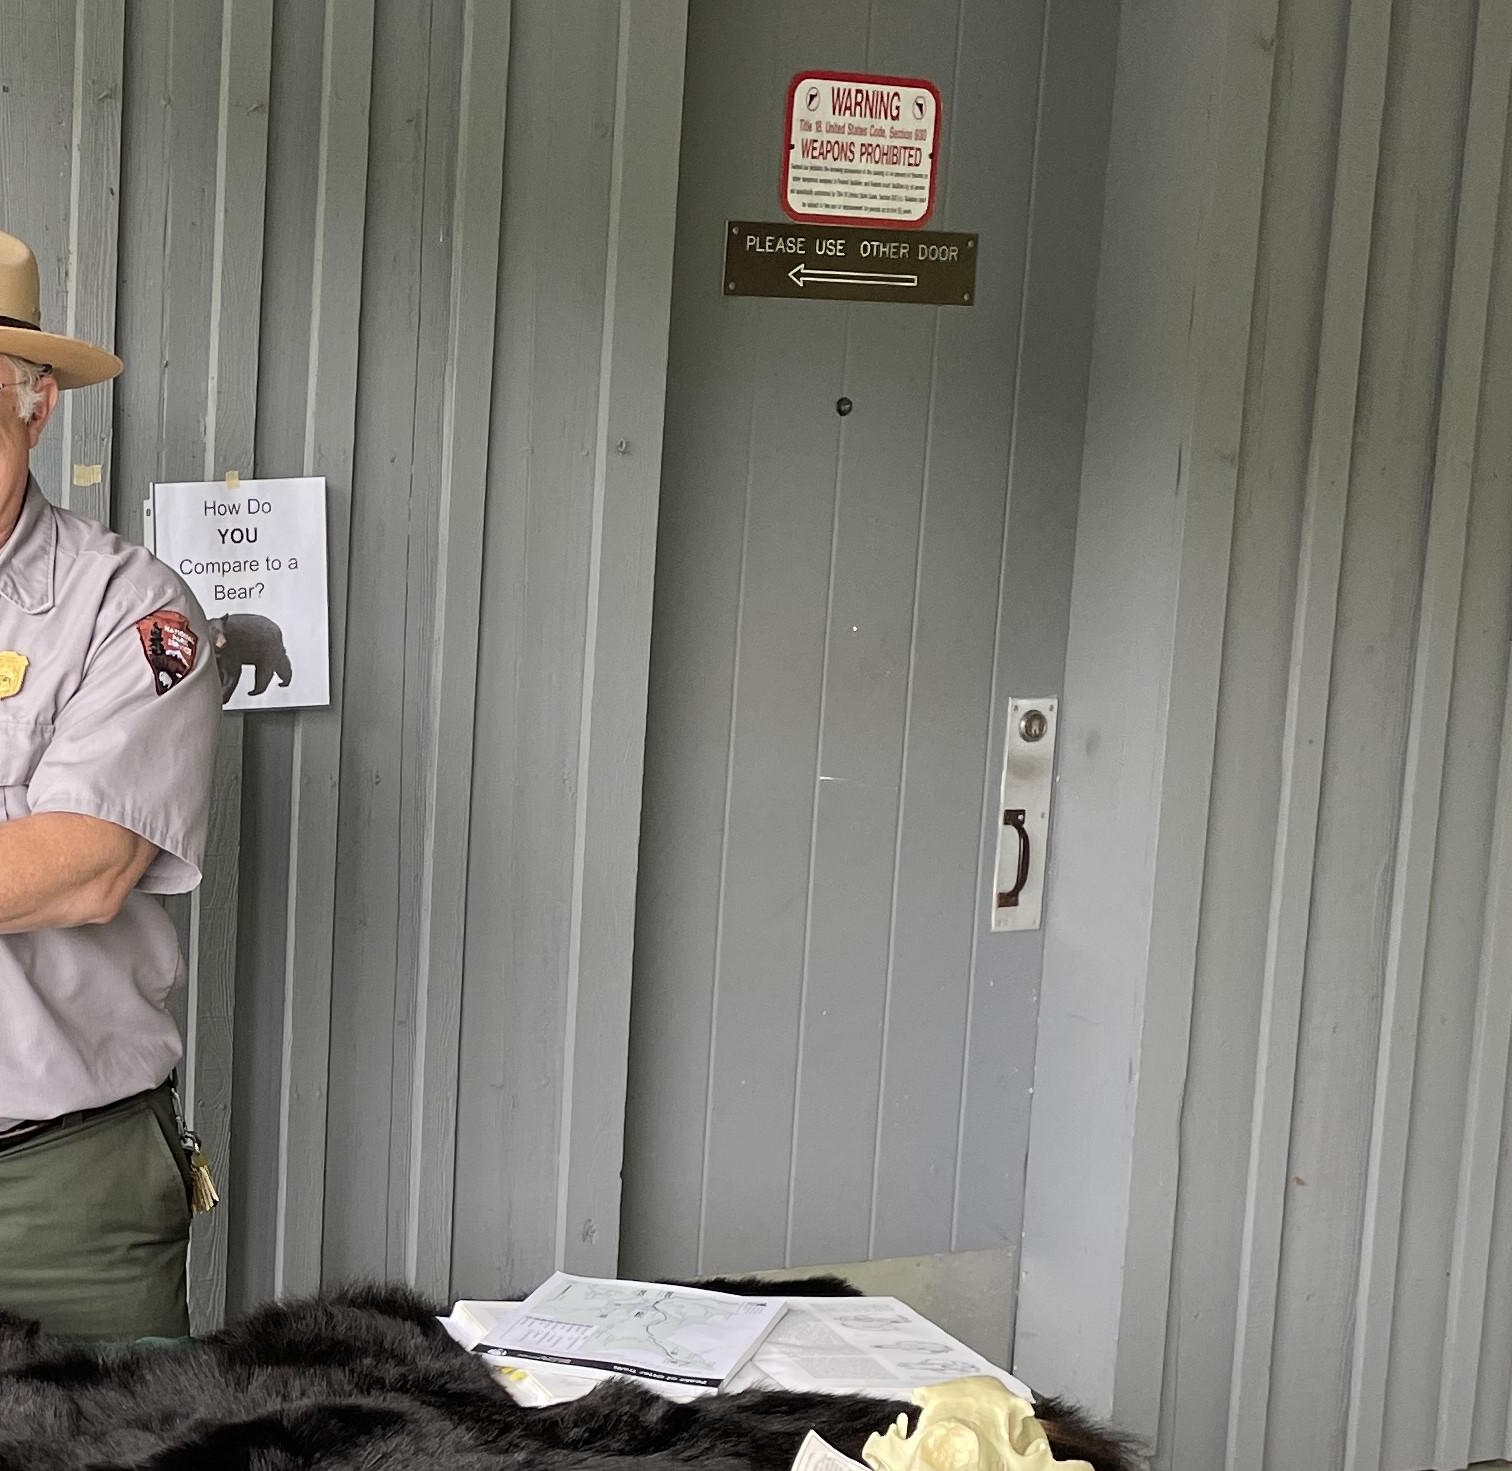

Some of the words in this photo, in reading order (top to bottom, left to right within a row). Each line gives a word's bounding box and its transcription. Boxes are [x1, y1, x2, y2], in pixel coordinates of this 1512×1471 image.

[831, 87, 901, 121] WARNING
[799, 119, 813, 132] Title
[825, 121, 846, 135] United
[848, 123, 868, 137] States
[801, 138, 856, 163] WEAPONS
[860, 143, 922, 167] PROHIBITED
[746, 235, 807, 254] PLEASE
[815, 239, 846, 256] USE
[860, 241, 910, 258] OTHER
[918, 244, 959, 262] DOOR
[203, 500, 241, 517] How
[247, 498, 272, 514] Do
[217, 527, 258, 544] YOU
[179, 559, 259, 577] Compare
[265, 556, 282, 571] to
[288, 557, 298, 570] a
[214, 582, 265, 601] Bear?
